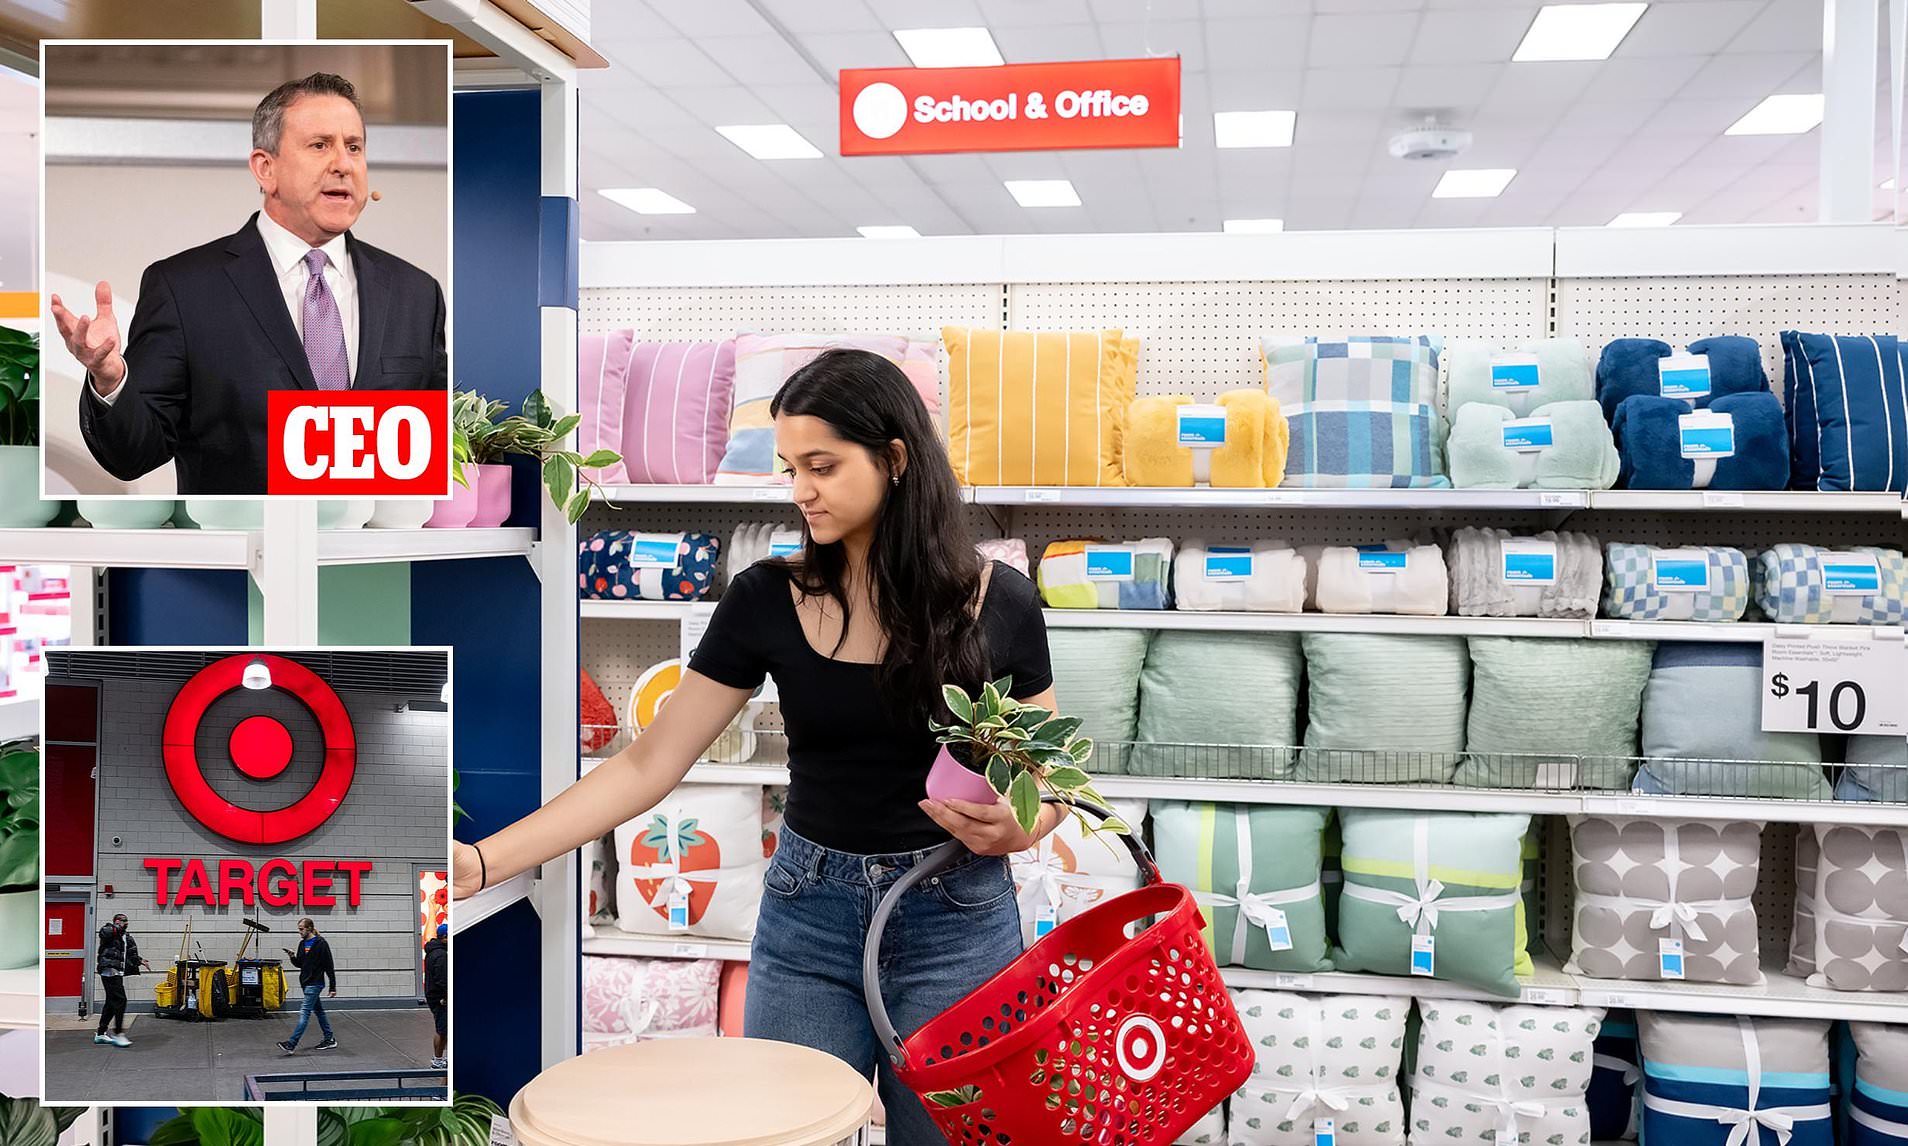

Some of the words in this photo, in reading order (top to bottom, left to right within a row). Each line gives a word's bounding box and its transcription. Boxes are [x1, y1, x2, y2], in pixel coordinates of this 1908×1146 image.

[913, 93, 1017, 124] School
[1024, 92, 1049, 119] &
[1054, 90, 1149, 118] Office
[1770, 672, 1866, 731] $10
[143, 858, 373, 907] TARGET
